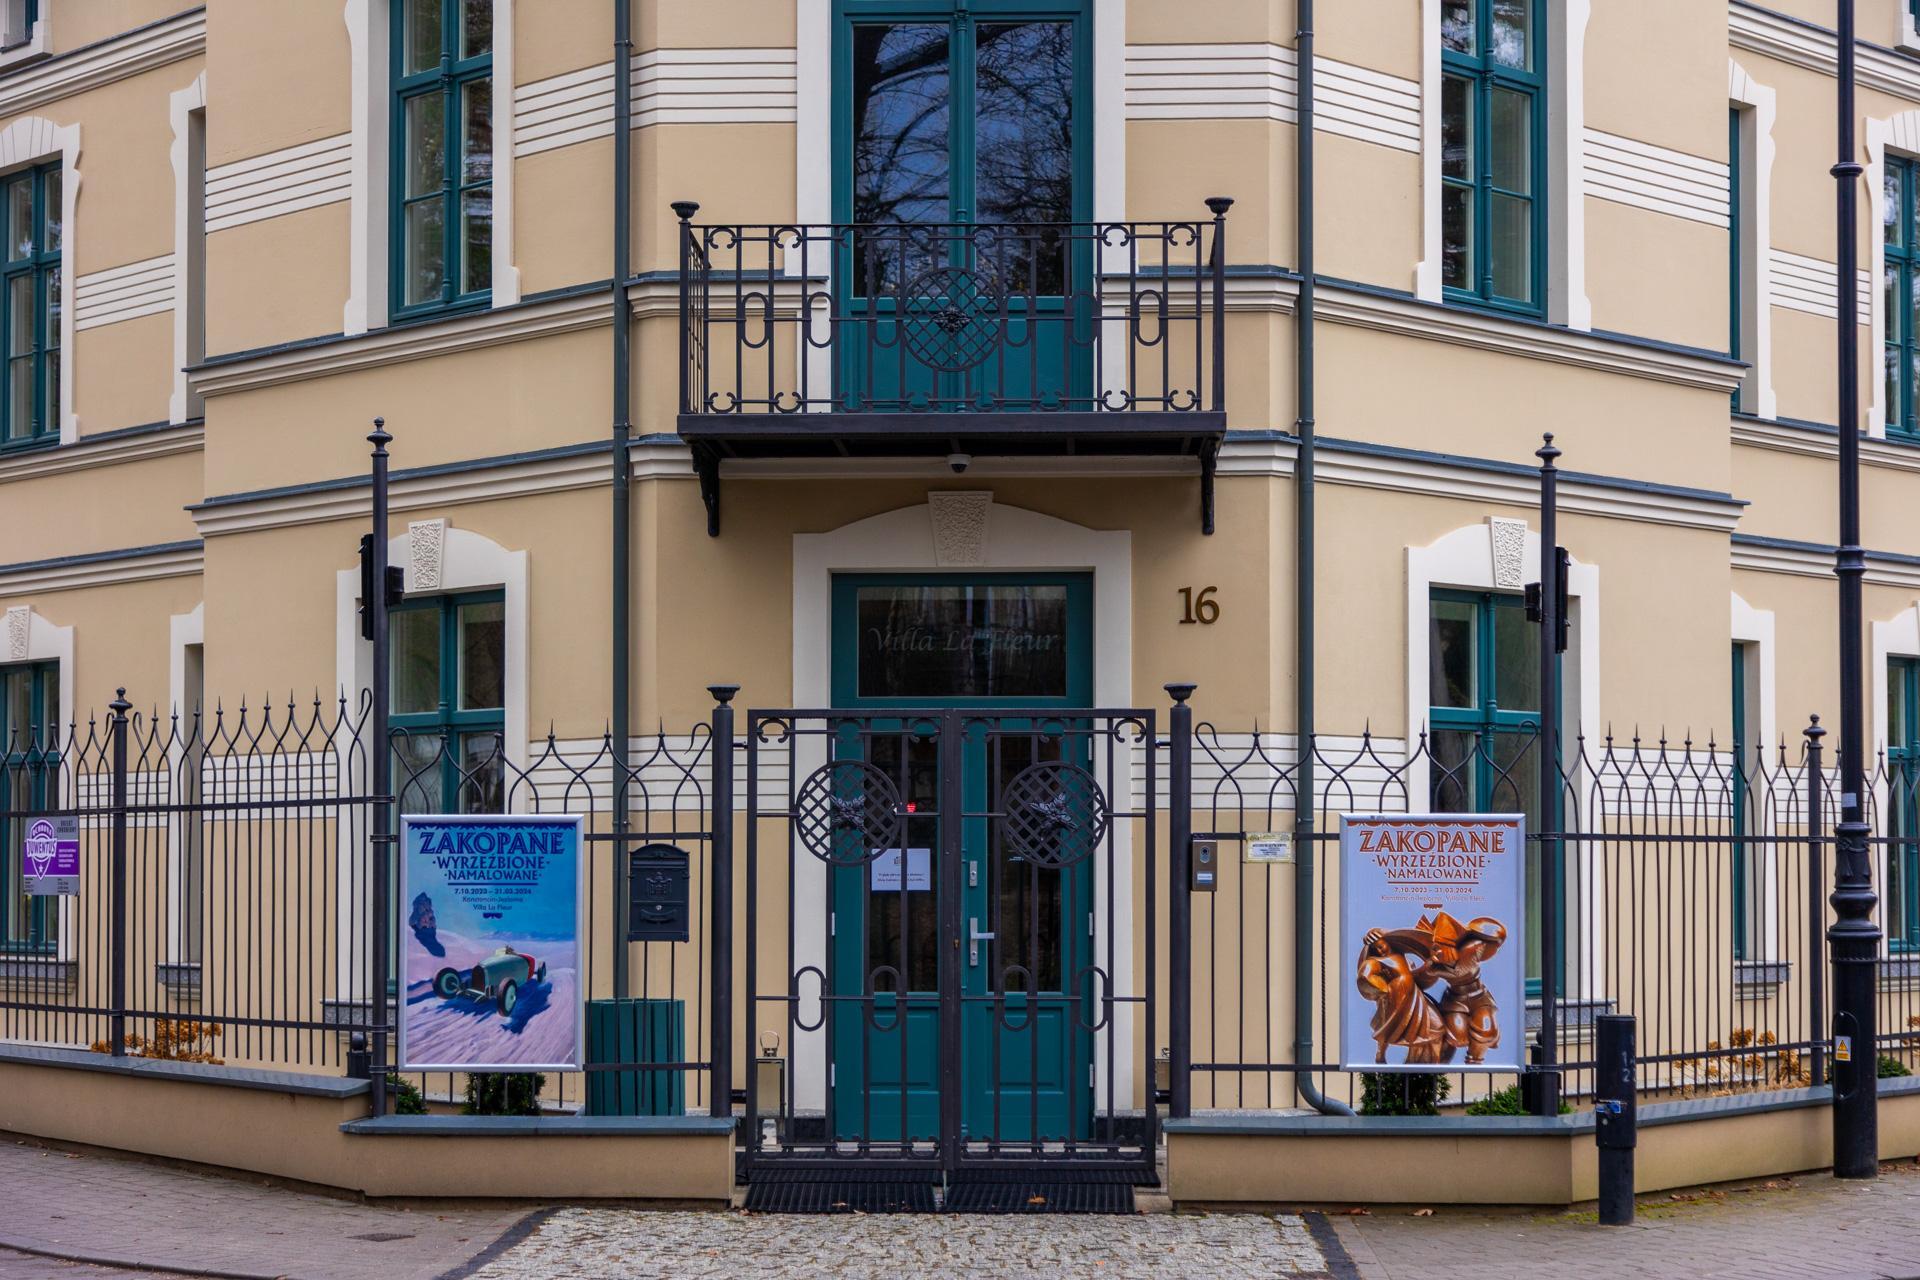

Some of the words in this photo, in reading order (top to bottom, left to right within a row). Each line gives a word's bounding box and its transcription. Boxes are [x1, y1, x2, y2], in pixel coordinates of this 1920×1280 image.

[1178, 586, 1220, 624] 16
[868, 627, 933, 650] Villa
[942, 629, 976, 651] La
[989, 627, 1059, 650] Fleur
[28, 841, 56, 856] JUWENTUS
[419, 832, 565, 854] ZAKOPANE
[1359, 831, 1505, 853] ZAKOPANE
[437, 853, 546, 869] WYRZEŹBIONE
[1376, 852, 1486, 867] WYRZEŹBIONE
[447, 870, 538, 880] NAMALOWANE
[1387, 869, 1479, 879] NAMALOWANE
